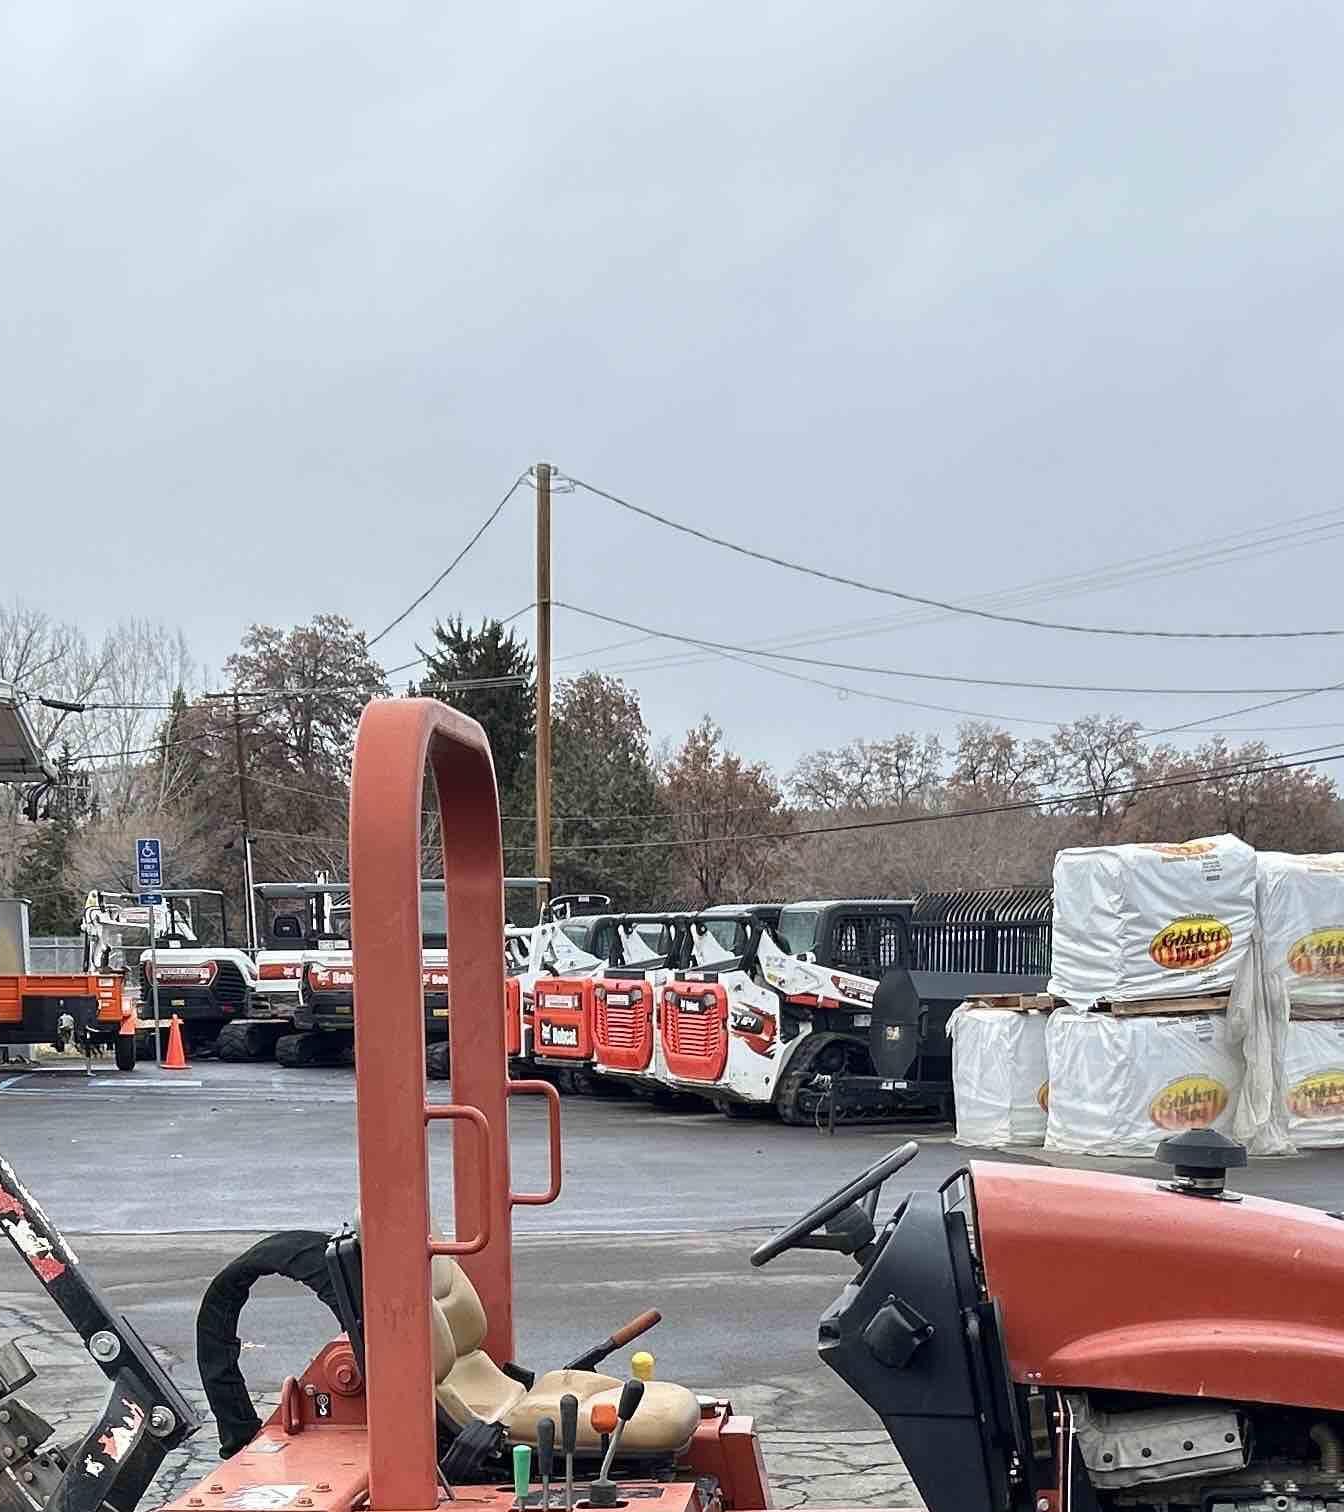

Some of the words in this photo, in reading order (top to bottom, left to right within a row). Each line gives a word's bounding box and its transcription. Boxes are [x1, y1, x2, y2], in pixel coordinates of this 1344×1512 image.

[1161, 927, 1223, 947] Golden
[332, 971, 353, 984] Bob
[552, 1026, 578, 1046] Bobcat
[1164, 1084, 1218, 1108] Golden
